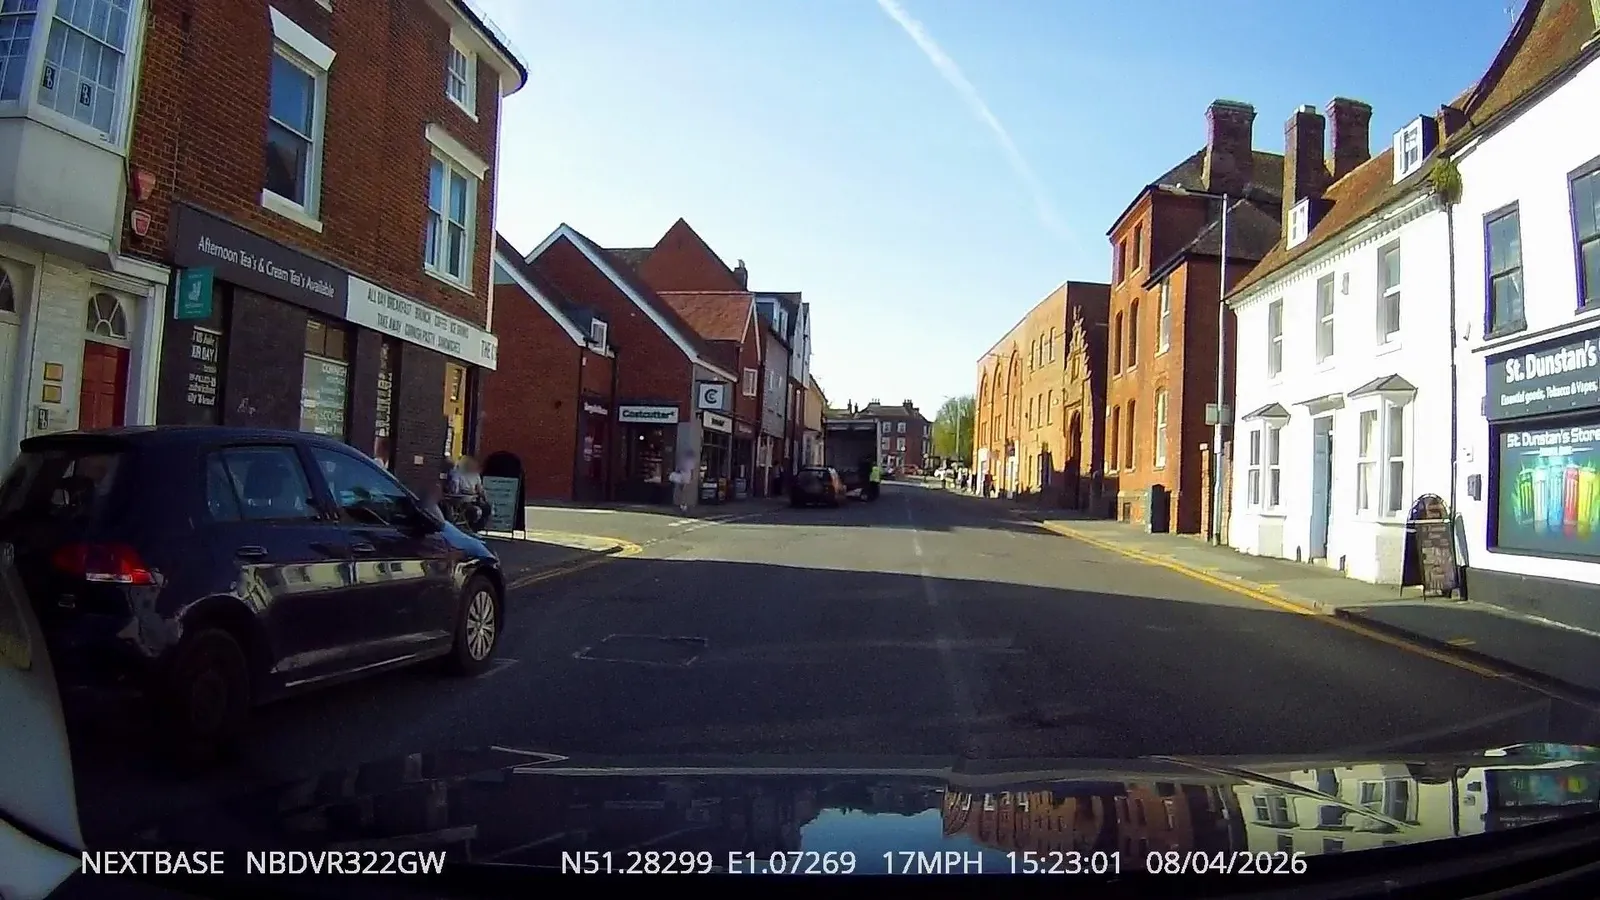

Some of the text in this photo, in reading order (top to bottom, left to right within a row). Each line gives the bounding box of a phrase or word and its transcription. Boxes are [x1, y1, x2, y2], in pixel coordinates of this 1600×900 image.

[198, 236, 335, 298] Afternoon Tea's & Cream Tea's Available
[1505, 340, 1598, 383] St. Dunstan's
[1546, 384, 1571, 399] Tobacco
[622, 409, 670, 419] Costcutter
[1521, 428, 1570, 447] Dunstan's
